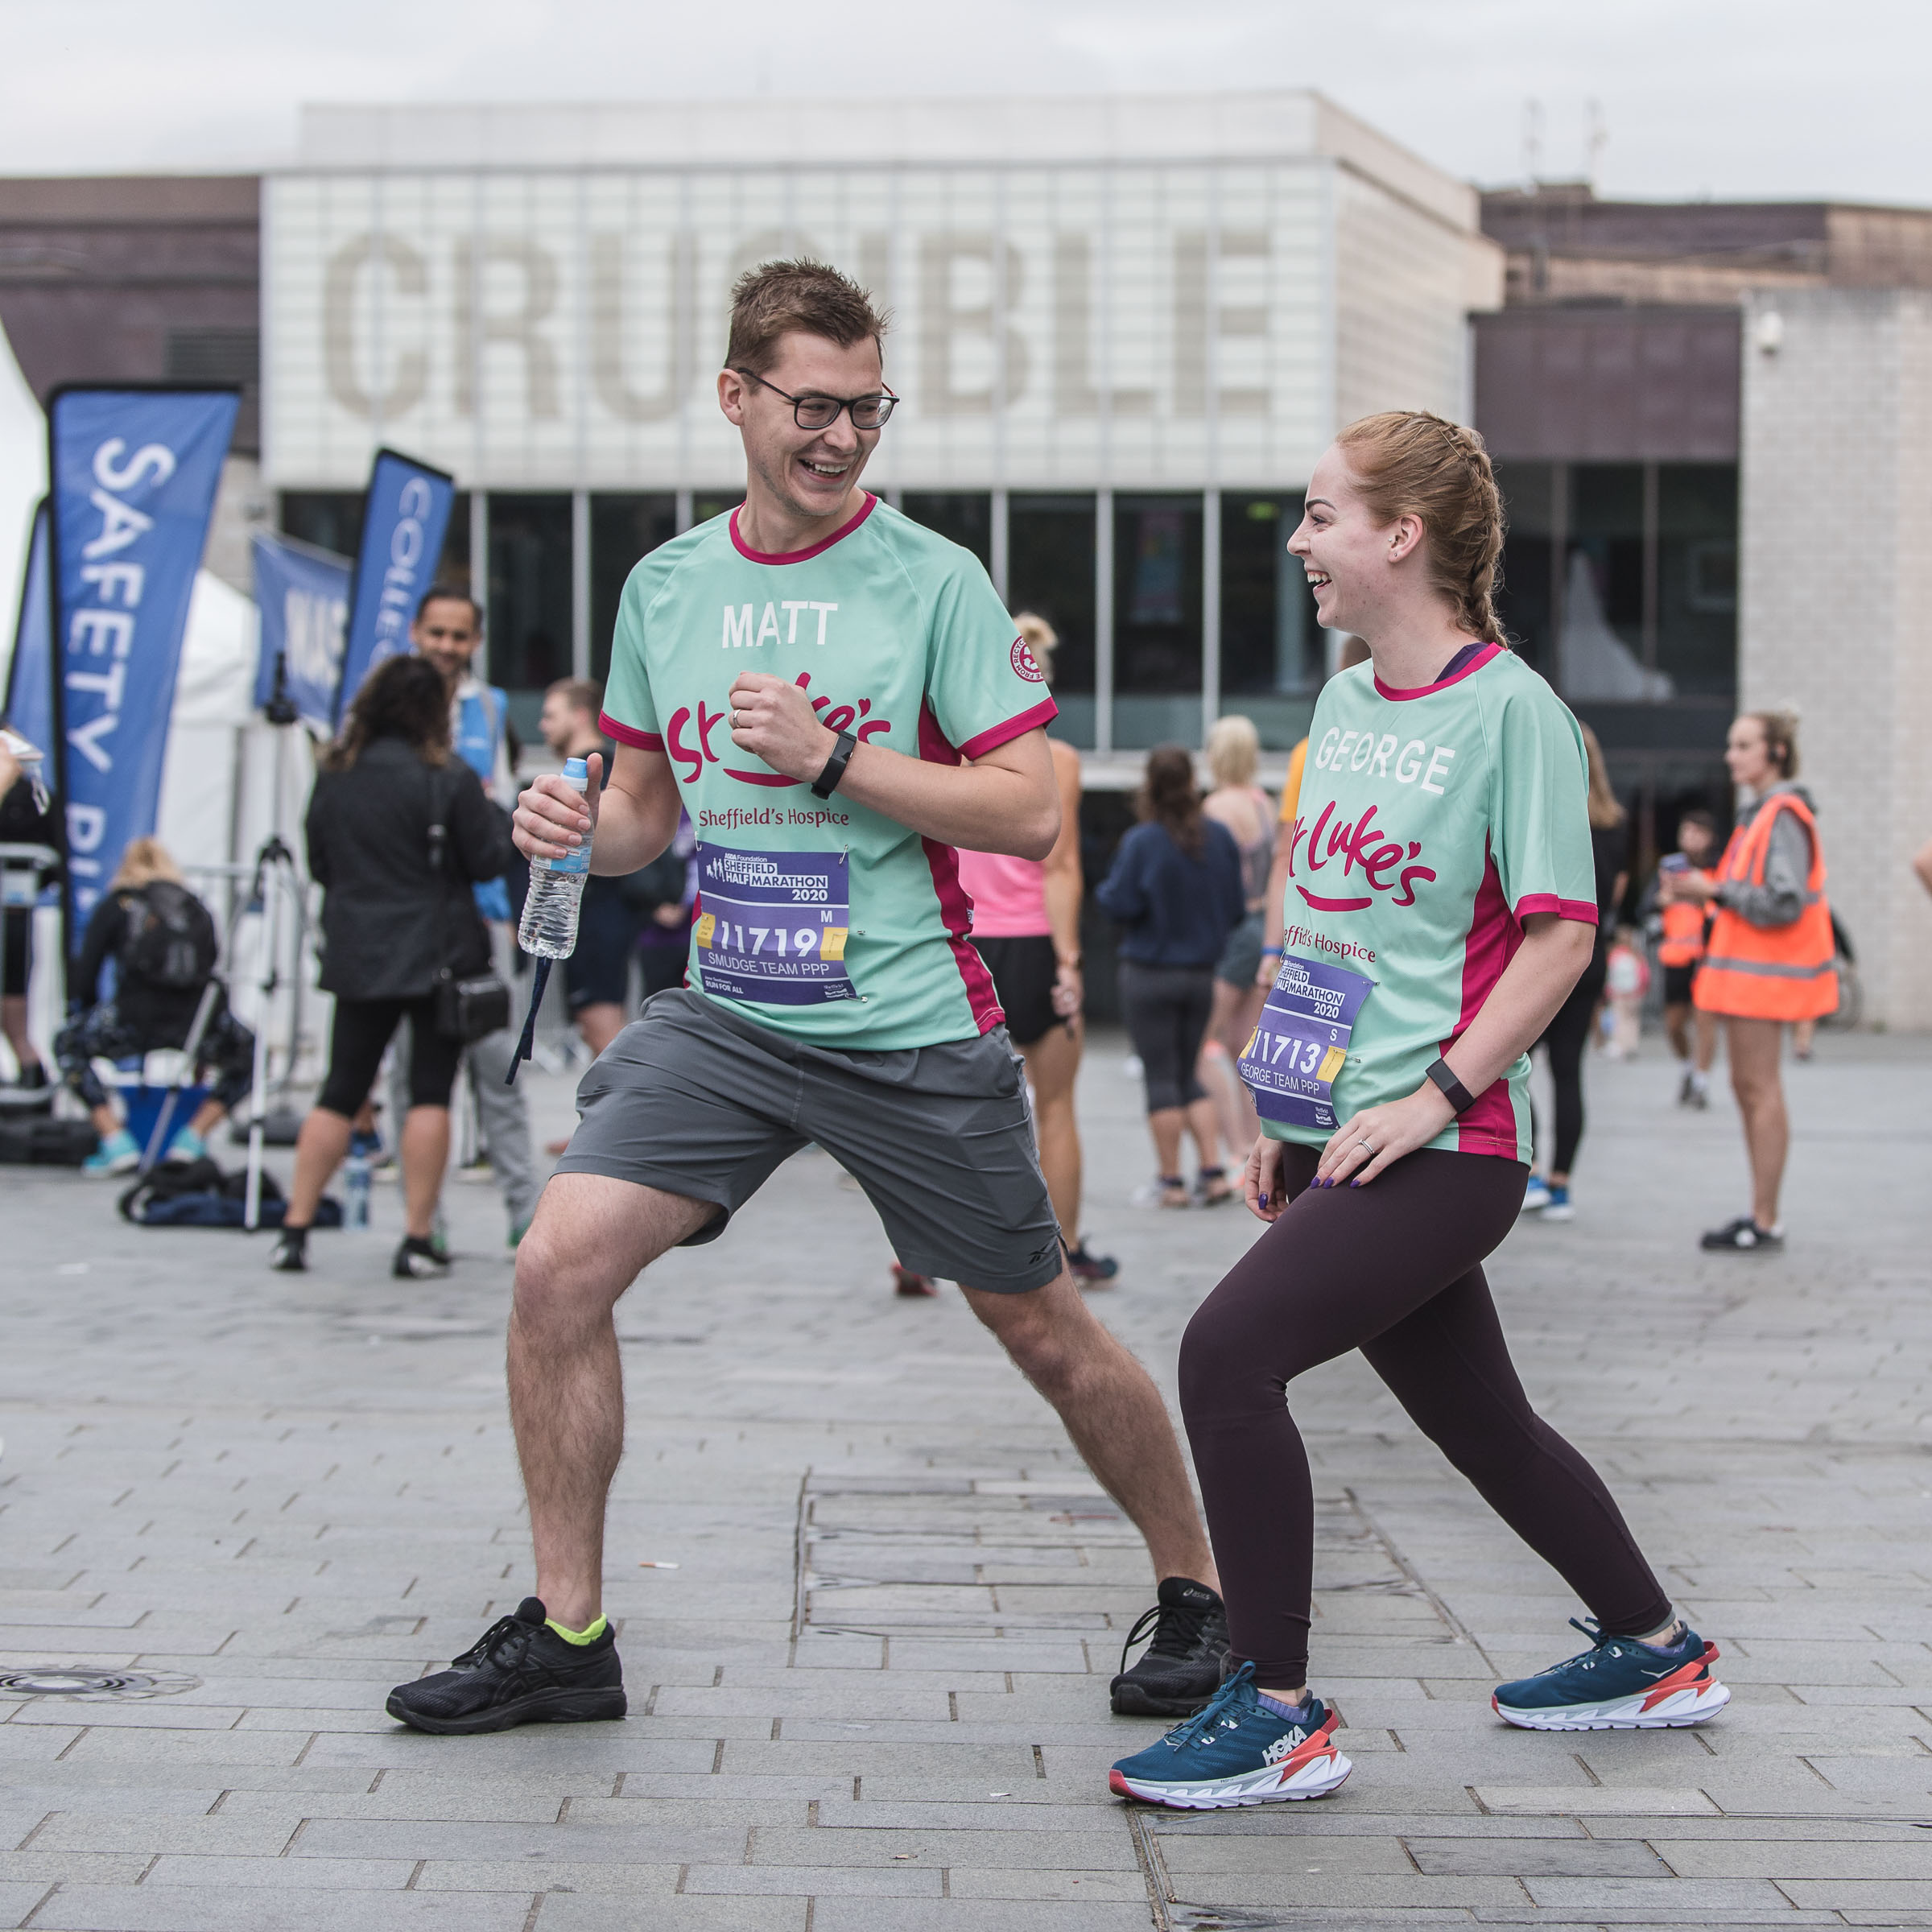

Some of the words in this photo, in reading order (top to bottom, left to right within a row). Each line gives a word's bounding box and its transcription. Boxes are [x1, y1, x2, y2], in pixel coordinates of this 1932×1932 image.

[323, 227, 1274, 422] CRUBLE
[66, 437, 176, 775] SAFETY
[721, 600, 838, 649] MATT
[1013, 640, 1024, 663] RECYC
[1016, 664, 1034, 679] FROM
[1315, 726, 1456, 796] GEORGE
[699, 807, 783, 830] Sheffield's
[788, 807, 849, 828] Hospice
[1307, 800, 1437, 907] Luke's
[725, 860, 775, 874] SHEFFIELD
[725, 872, 749, 885] HALF
[751, 875, 826, 888] MARATHON
[791, 889, 828, 902] 2020
[820, 910, 832, 923] M
[721, 920, 818, 957] 11719
[1315, 932, 1376, 963] Hospice
[708, 952, 758, 972] SMUDGE
[760, 961, 799, 975] TEAM
[802, 964, 830, 976] PPP
[705, 980, 718, 989] RUN
[718, 983, 731, 992] FOR
[732, 986, 745, 994] ALL
[1288, 982, 1344, 1005] MARATHON
[1314, 1001, 1340, 1019] 2020
[1329, 1028, 1338, 1042] S
[1250, 1030, 1321, 1074] 11713
[1241, 1063, 1271, 1084] GEORGE
[1274, 1071, 1299, 1091] TEAM
[1301, 1080, 1320, 1096] PPP
[1261, 1724, 1308, 1767] HOKA
